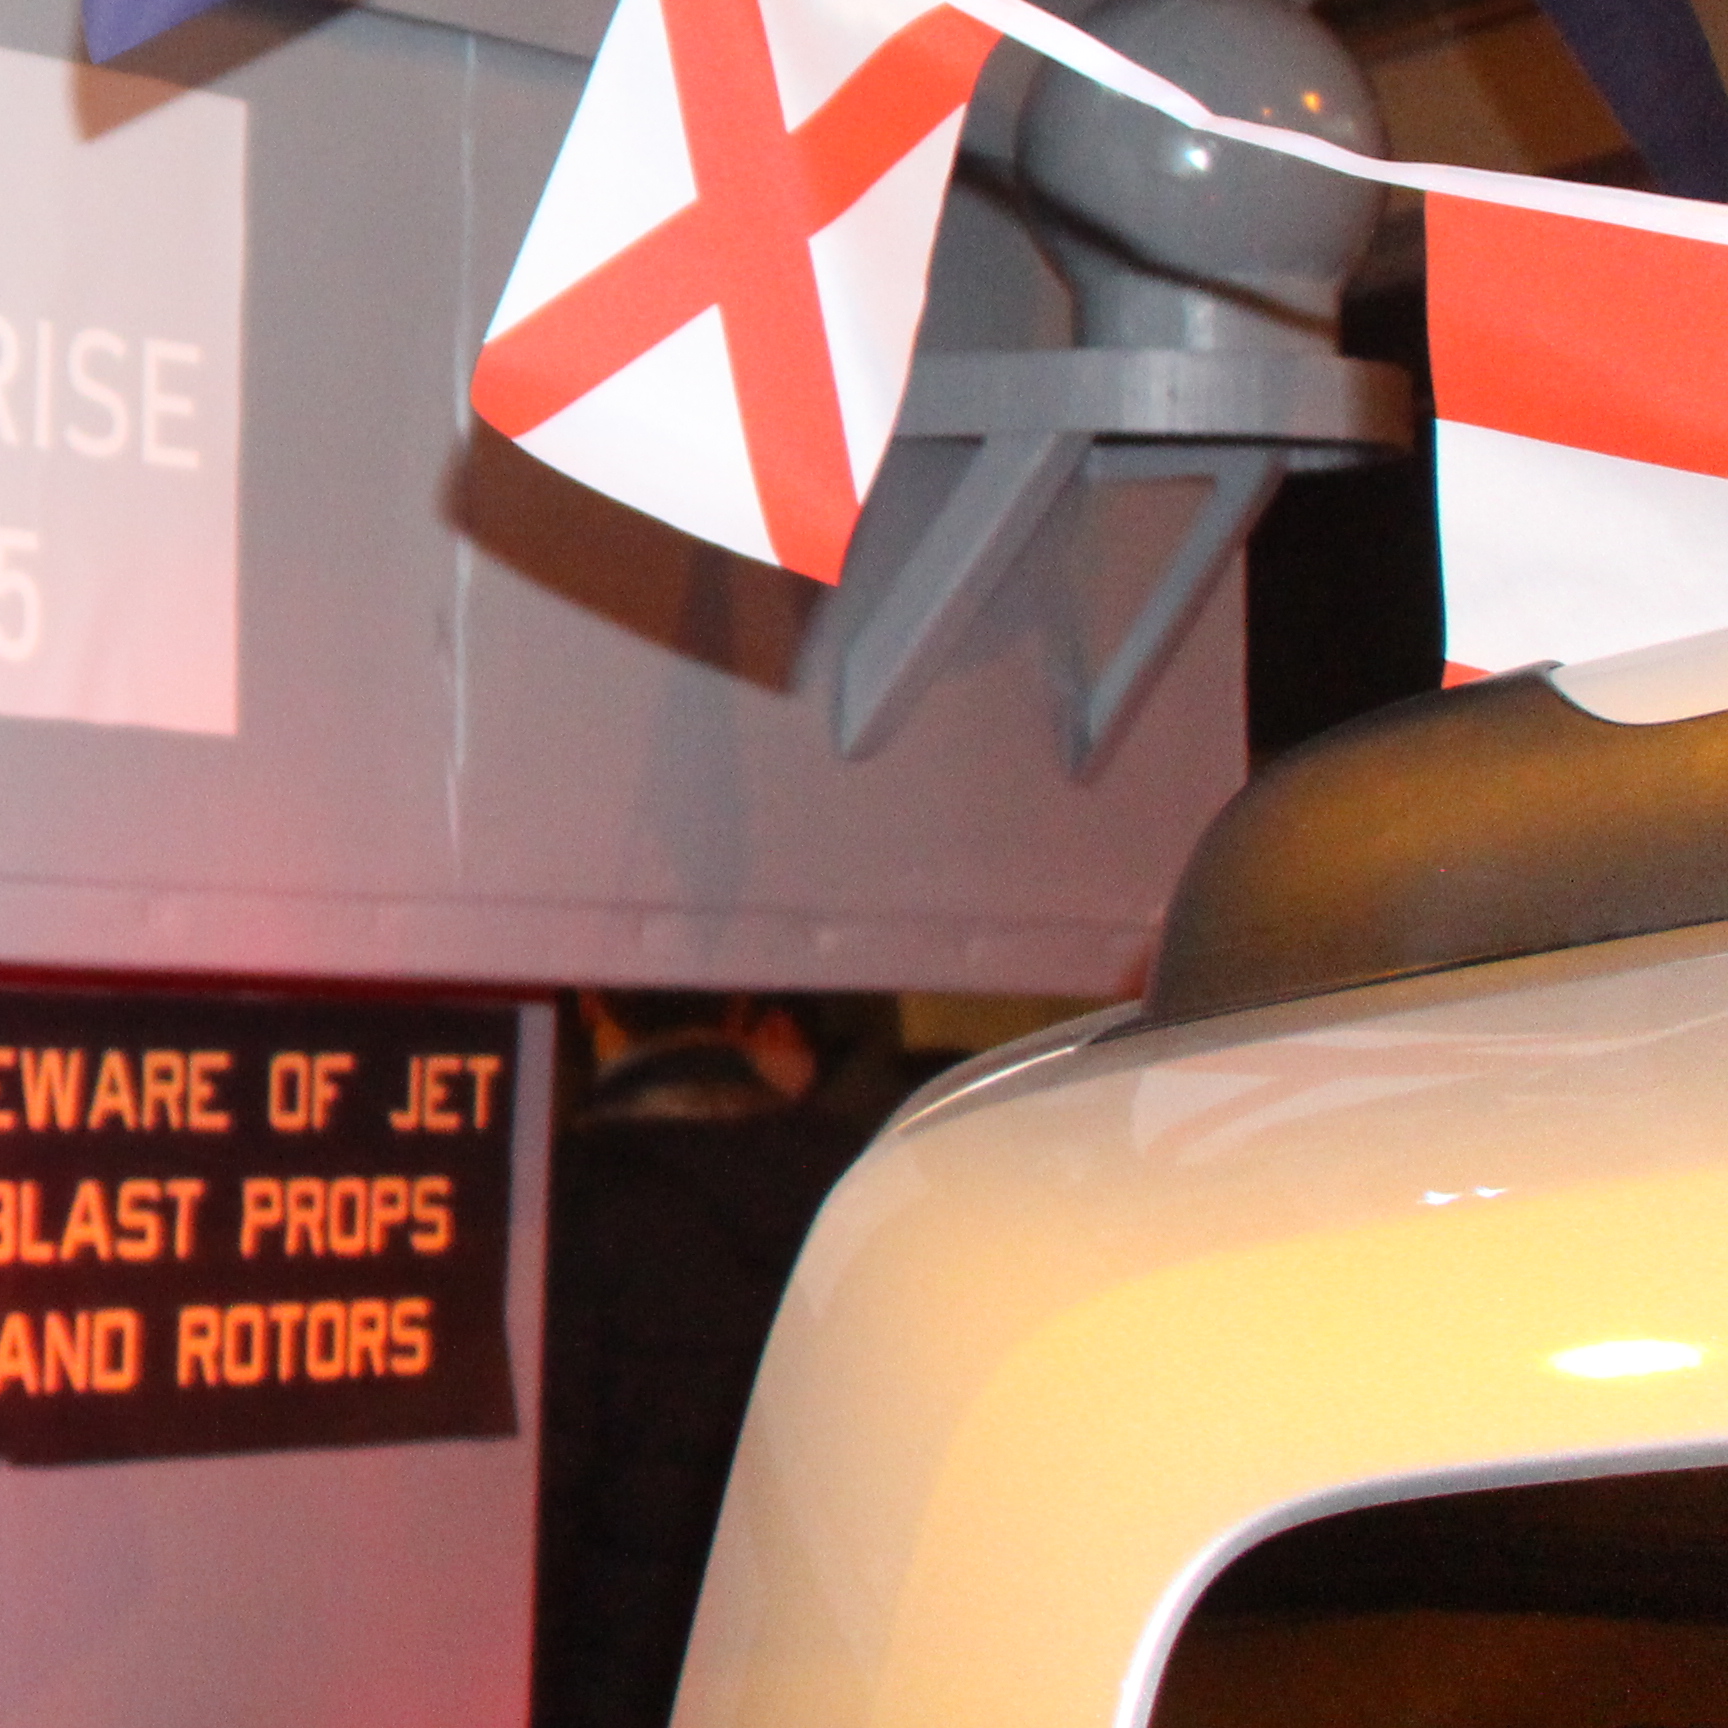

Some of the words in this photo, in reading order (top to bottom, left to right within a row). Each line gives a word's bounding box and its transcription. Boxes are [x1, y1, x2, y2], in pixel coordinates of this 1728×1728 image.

[266, 1051, 356, 1132] OF
[388, 1054, 501, 1133] JET
[239, 1175, 454, 1257] PROPS
[177, 1297, 433, 1387] ROTORS
